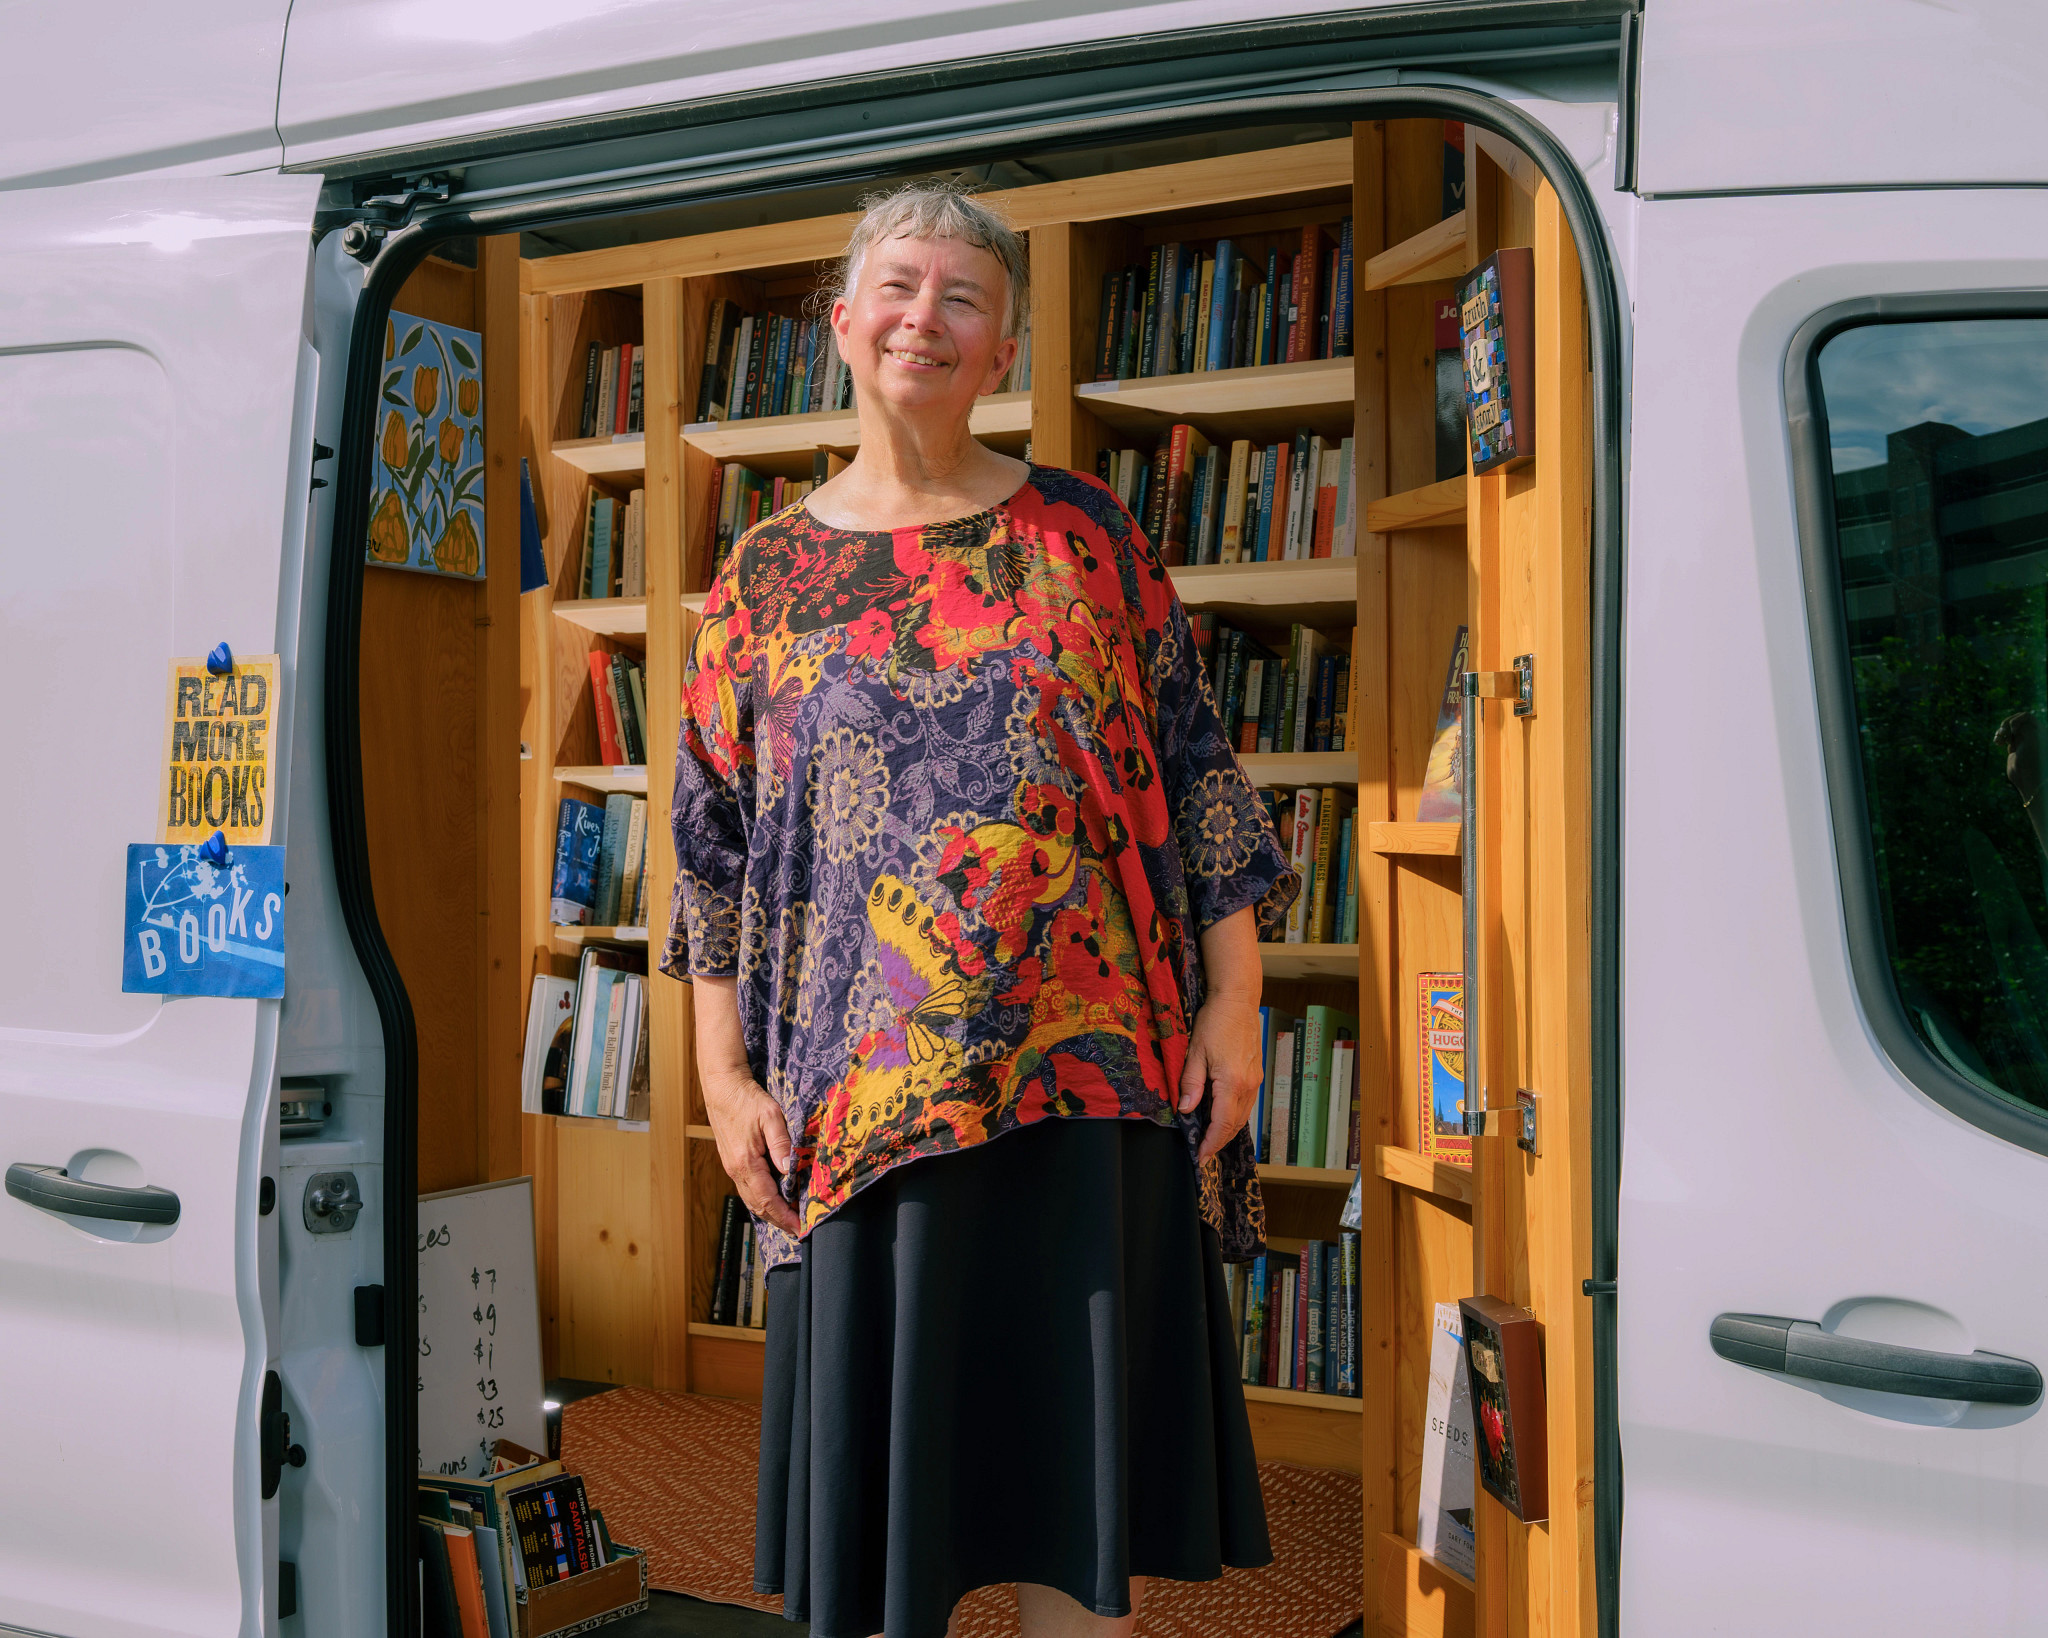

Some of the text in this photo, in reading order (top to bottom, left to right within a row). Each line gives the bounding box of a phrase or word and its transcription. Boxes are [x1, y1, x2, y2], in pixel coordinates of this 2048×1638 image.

[1163, 249, 1175, 304] DONNA LEON
[1342, 254, 1352, 269] the
[1148, 251, 1159, 306] DONNA LEON
[1341, 271, 1349, 291] man
[1339, 293, 1350, 313] who
[1463, 296, 1488, 326] truth
[1336, 315, 1348, 346] smiled
[587, 348, 596, 384] CHARLOTTE
[779, 341, 787, 364] WATER
[1472, 345, 1487, 387] &
[745, 362, 757, 414] POWER
[1475, 402, 1498, 428] story
[723, 470, 735, 518] THE NEW LIFE
[1151, 454, 1169, 536] Song Yet Sung
[1161, 430, 1184, 551] Ian McEwan Sweet Tooth
[1263, 449, 1276, 513] FIGHT SONG
[719, 540, 727, 556] TOM
[1229, 652, 1238, 673] Berry
[176, 674, 267, 718] READ
[1227, 675, 1236, 702] Pickers
[1286, 686, 1294, 710] BRIDGE
[171, 719, 266, 763] MORE
[1297, 719, 1305, 741] Hour
[168, 765, 265, 828] BOOKS
[575, 806, 601, 836] River
[1321, 804, 1332, 845] DANGEROUS
[557, 829, 571, 848] River
[627, 803, 642, 876] PIONEER WOMEN
[603, 819, 619, 892] JOHN IRVING
[1317, 848, 1327, 881] BUSINESS
[138, 887, 281, 979] BOOKS
[1451, 1006, 1462, 1016] THE
[601, 1020, 619, 1091] The Ballpark Book
[1305, 1016, 1314, 1066] TROLLOPE
[1313, 1021, 1321, 1063] JOANNA
[471, 1267, 497, 1294] $7
[473, 1303, 497, 1336] $9
[474, 1337, 493, 1371] $1
[477, 1377, 499, 1400] $3
[477, 1406, 504, 1428] $25
[1431, 1417, 1468, 1447] SEEDS
[583, 1520, 592, 1539] ENSK
